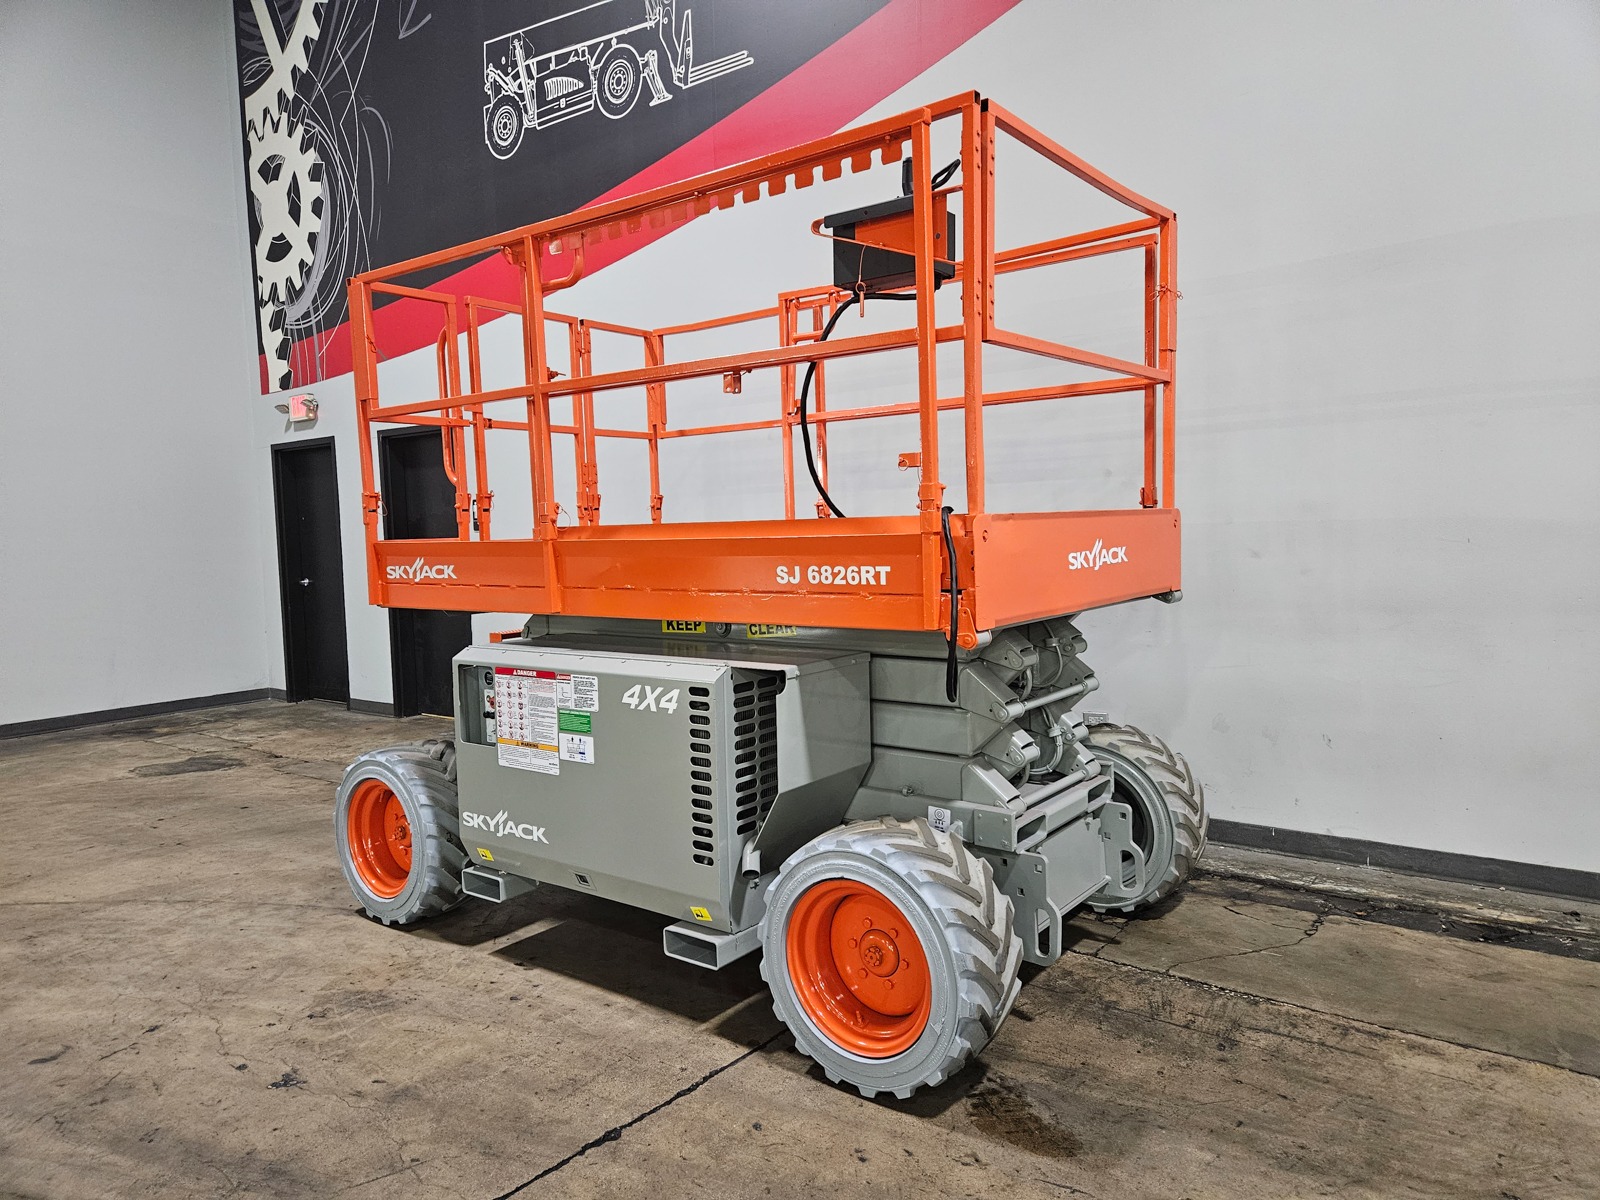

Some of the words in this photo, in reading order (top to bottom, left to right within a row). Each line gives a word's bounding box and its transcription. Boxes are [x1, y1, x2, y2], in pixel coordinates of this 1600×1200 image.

[1067, 538, 1129, 571] SKYJACK
[386, 557, 457, 582] SKYJACK
[776, 565, 801, 585] SJ
[807, 565, 891, 586] 6826RT
[666, 620, 702, 631] KEEP
[749, 624, 795, 635] CLEAR
[621, 684, 680, 714] 4X4
[462, 809, 550, 845] SKYJACK
